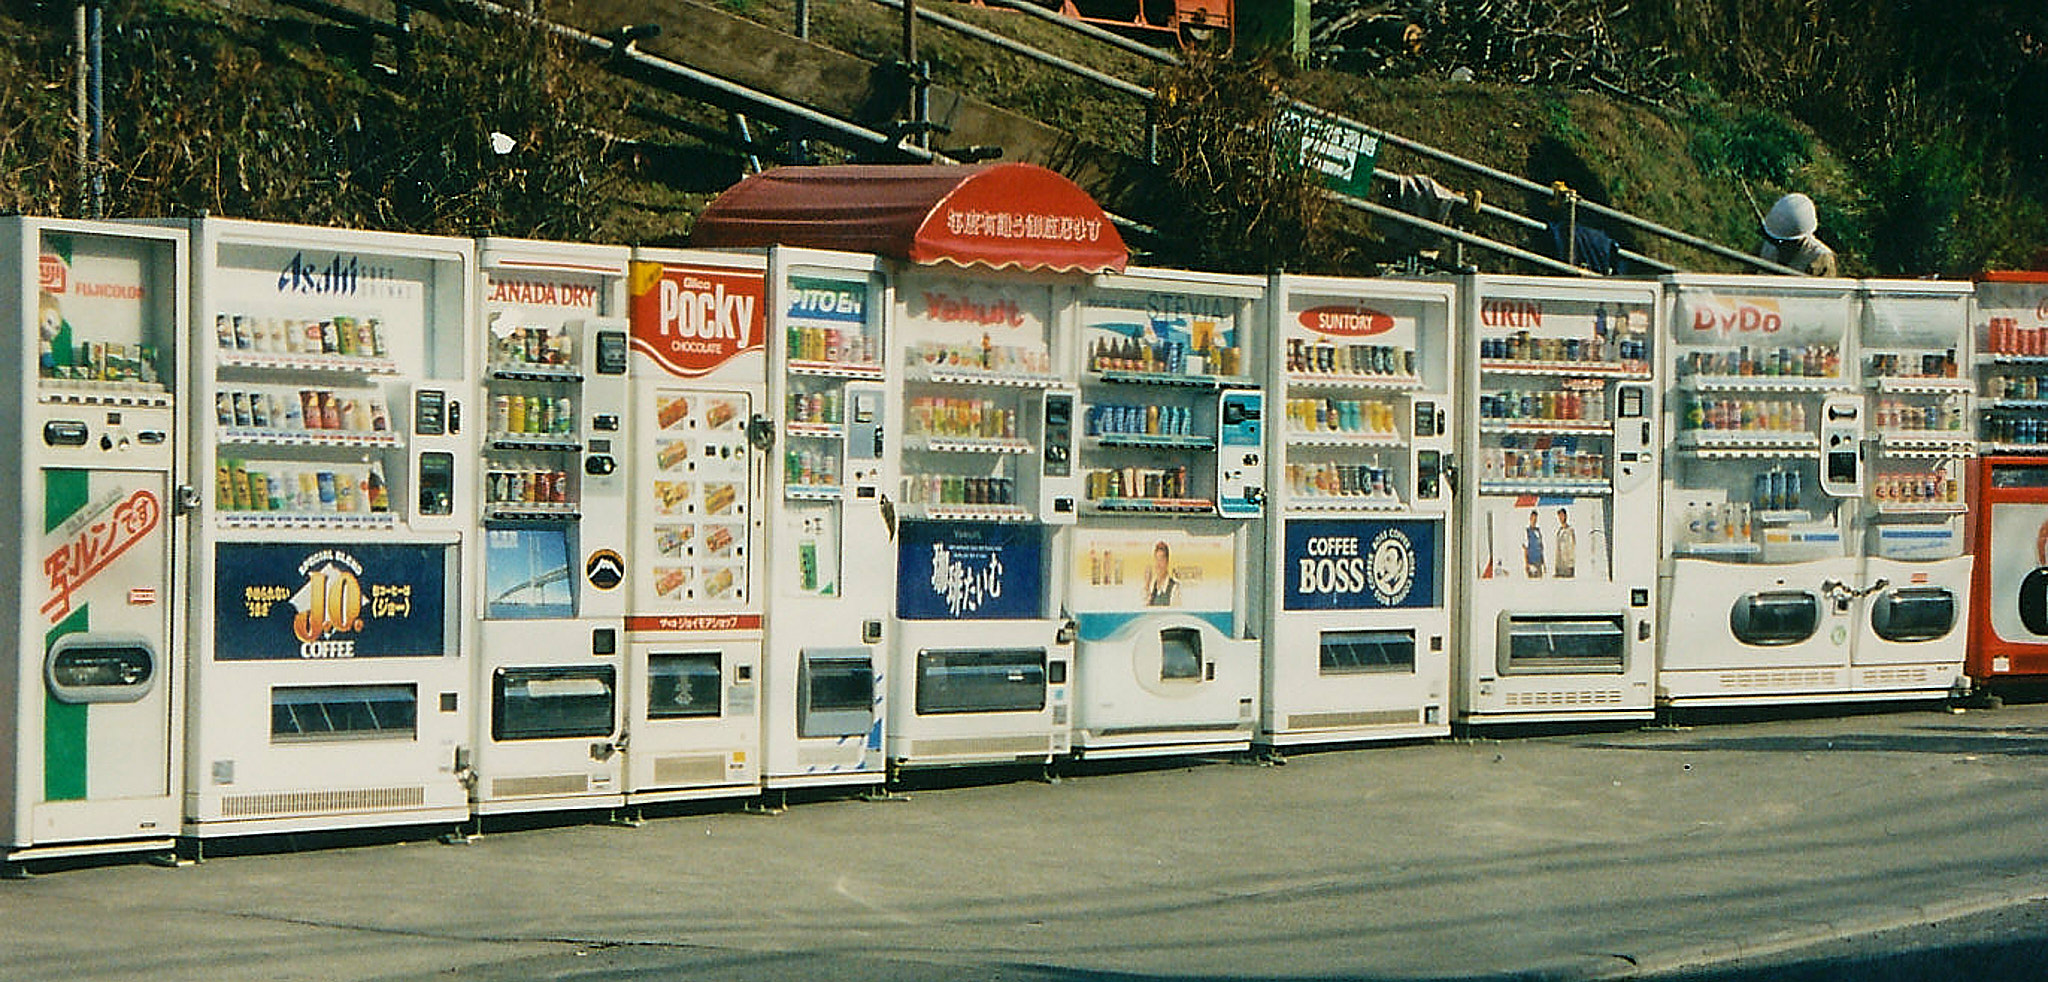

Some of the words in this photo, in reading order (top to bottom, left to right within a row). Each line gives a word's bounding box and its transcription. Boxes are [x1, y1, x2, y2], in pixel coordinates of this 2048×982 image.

[278, 251, 357, 296] Asahi
[75, 282, 145, 299] FUJICOLOR
[560, 284, 597, 308] DRY
[660, 279, 755, 349] Pocky
[922, 291, 1025, 328] Yakult
[1318, 312, 1374, 331] SUNTORY
[1693, 307, 1782, 336] DyDo
[671, 341, 723, 355] CHOCOLATE
[1308, 537, 1359, 556] COFFEE
[931, 541, 1002, 618] 珈琲たいむ
[1298, 558, 1365, 593] BOSS
[293, 570, 365, 643] J.O.
[300, 640, 355, 659] COFFEE
